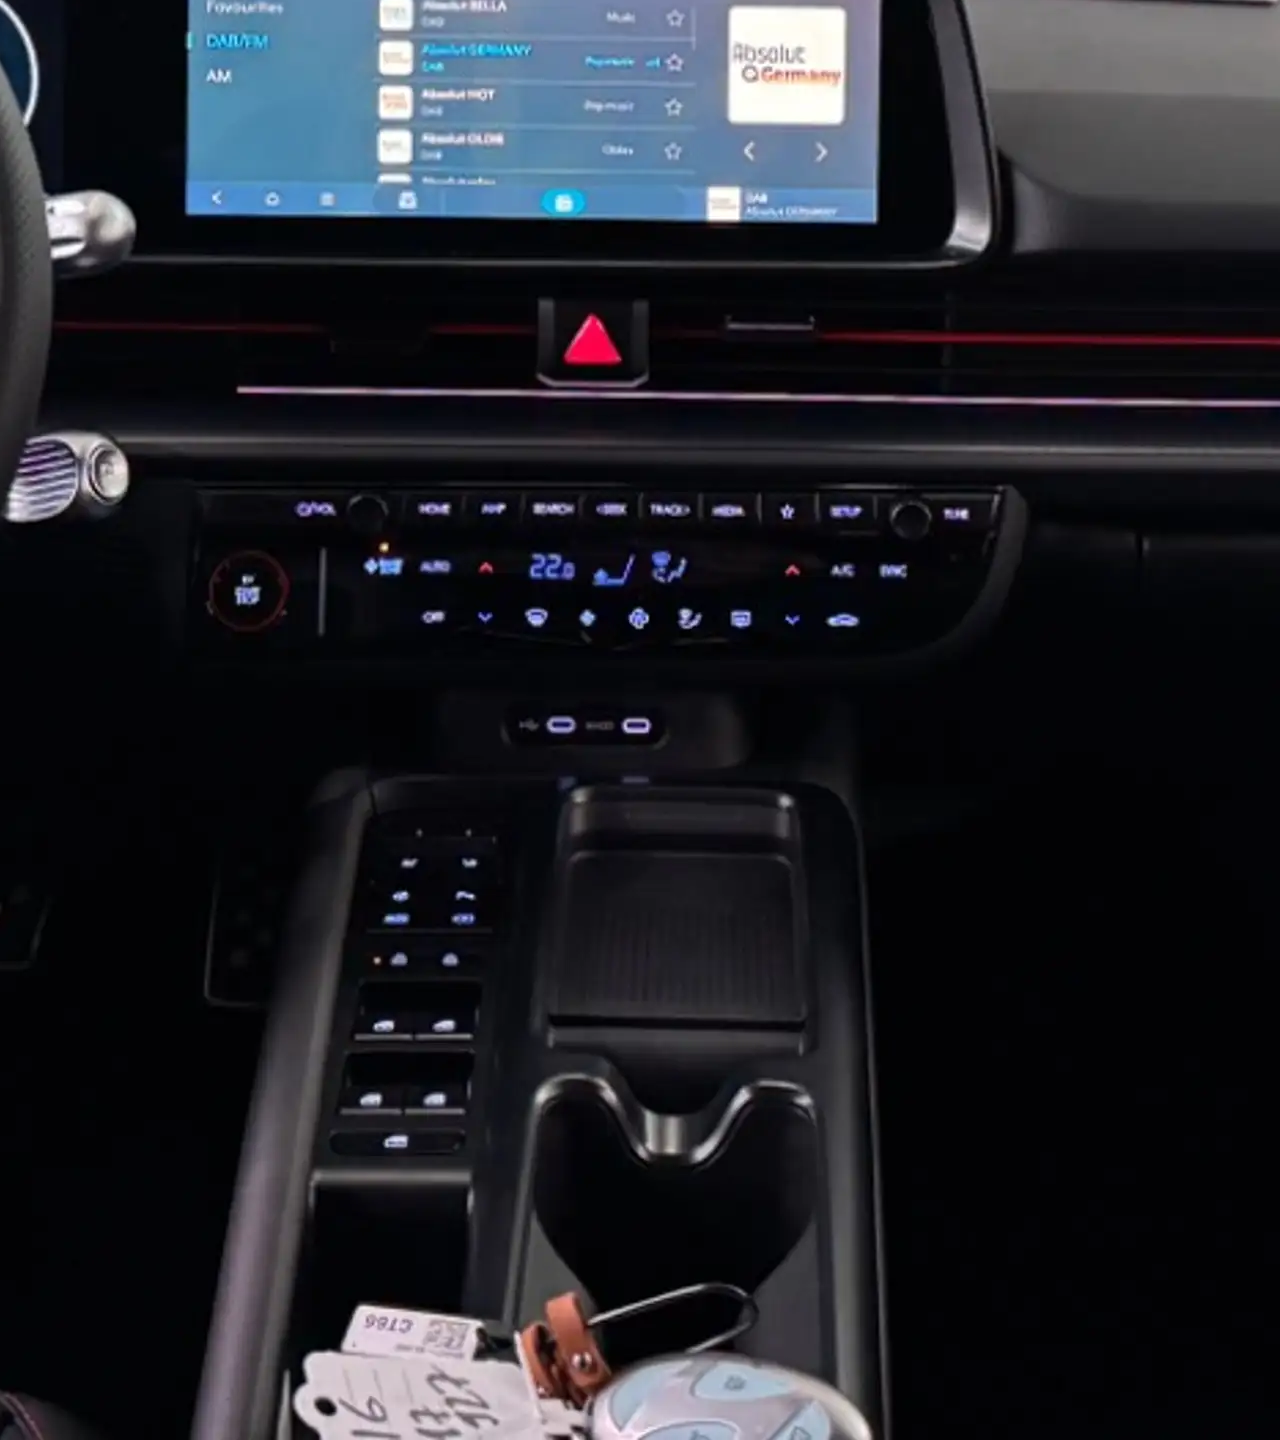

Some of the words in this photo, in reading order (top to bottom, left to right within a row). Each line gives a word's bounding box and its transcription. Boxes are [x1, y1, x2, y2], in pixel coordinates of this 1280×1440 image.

[206, 33, 269, 50] DAB/FM
[733, 42, 807, 64] Absolut
[206, 68, 233, 84] AM
[761, 66, 842, 87] Germany
